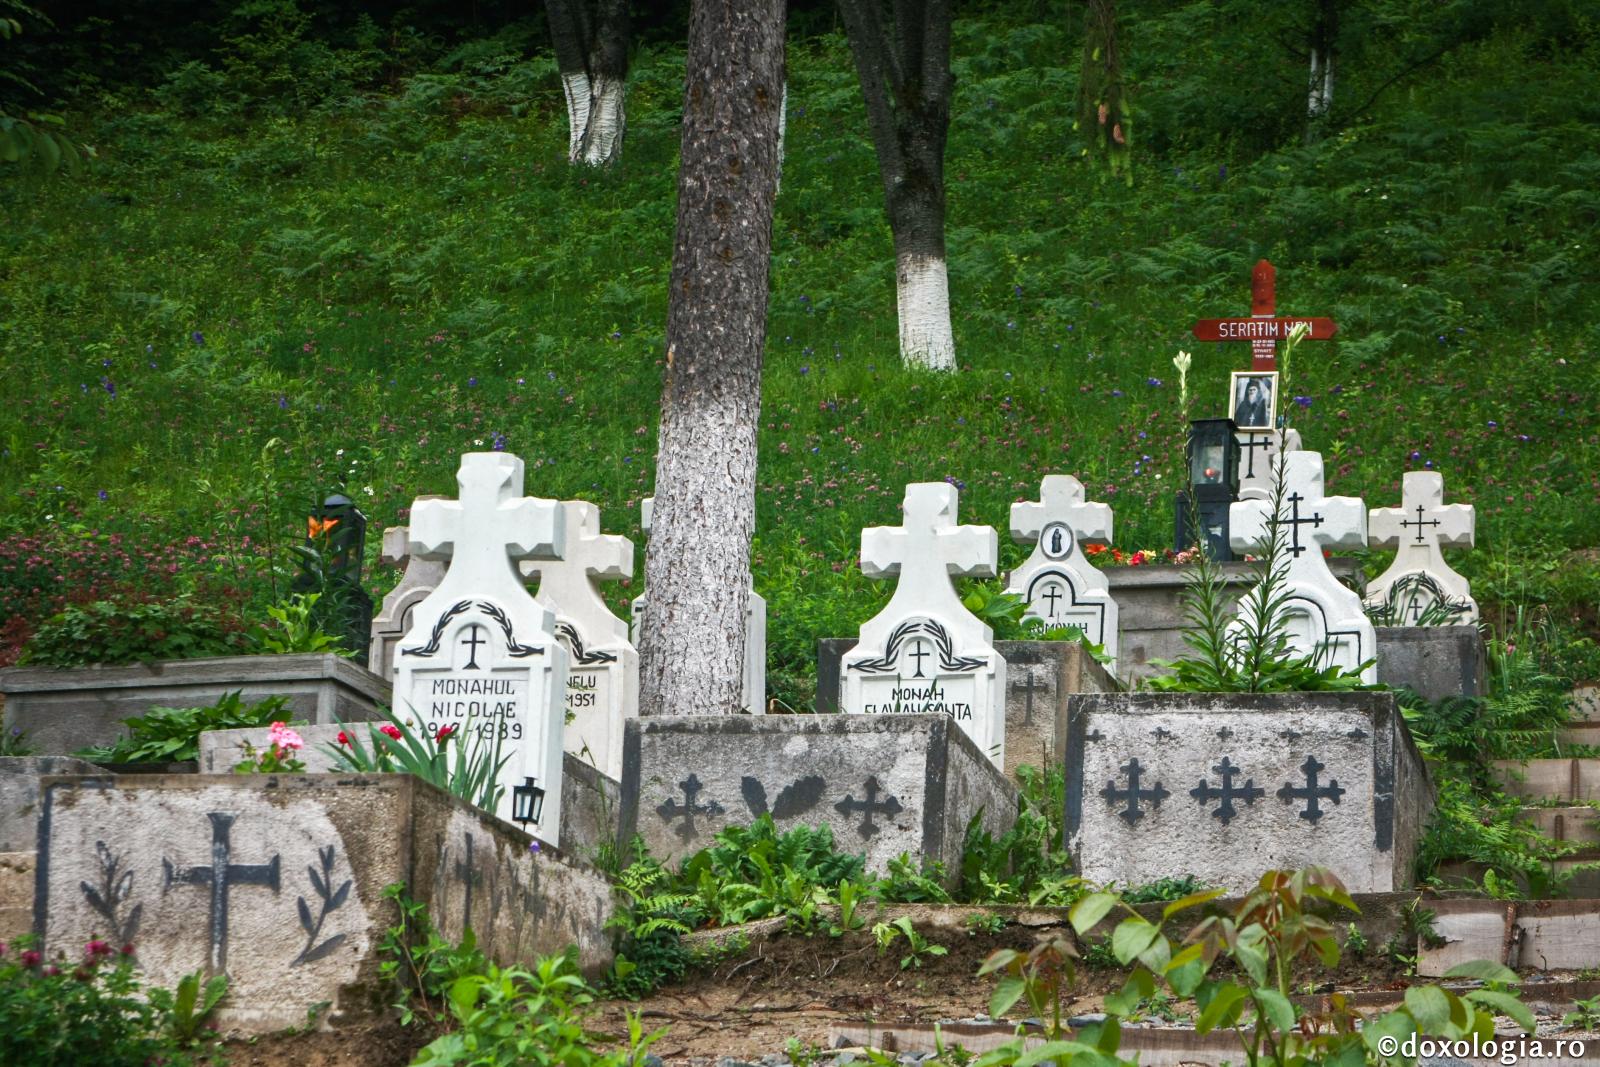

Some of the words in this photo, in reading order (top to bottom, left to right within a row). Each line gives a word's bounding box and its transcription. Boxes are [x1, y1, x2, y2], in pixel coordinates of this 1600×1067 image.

[432, 679, 515, 695] MONAHUL
[892, 687, 944, 701] MONAH
[432, 701, 516, 718] NICOLAE
